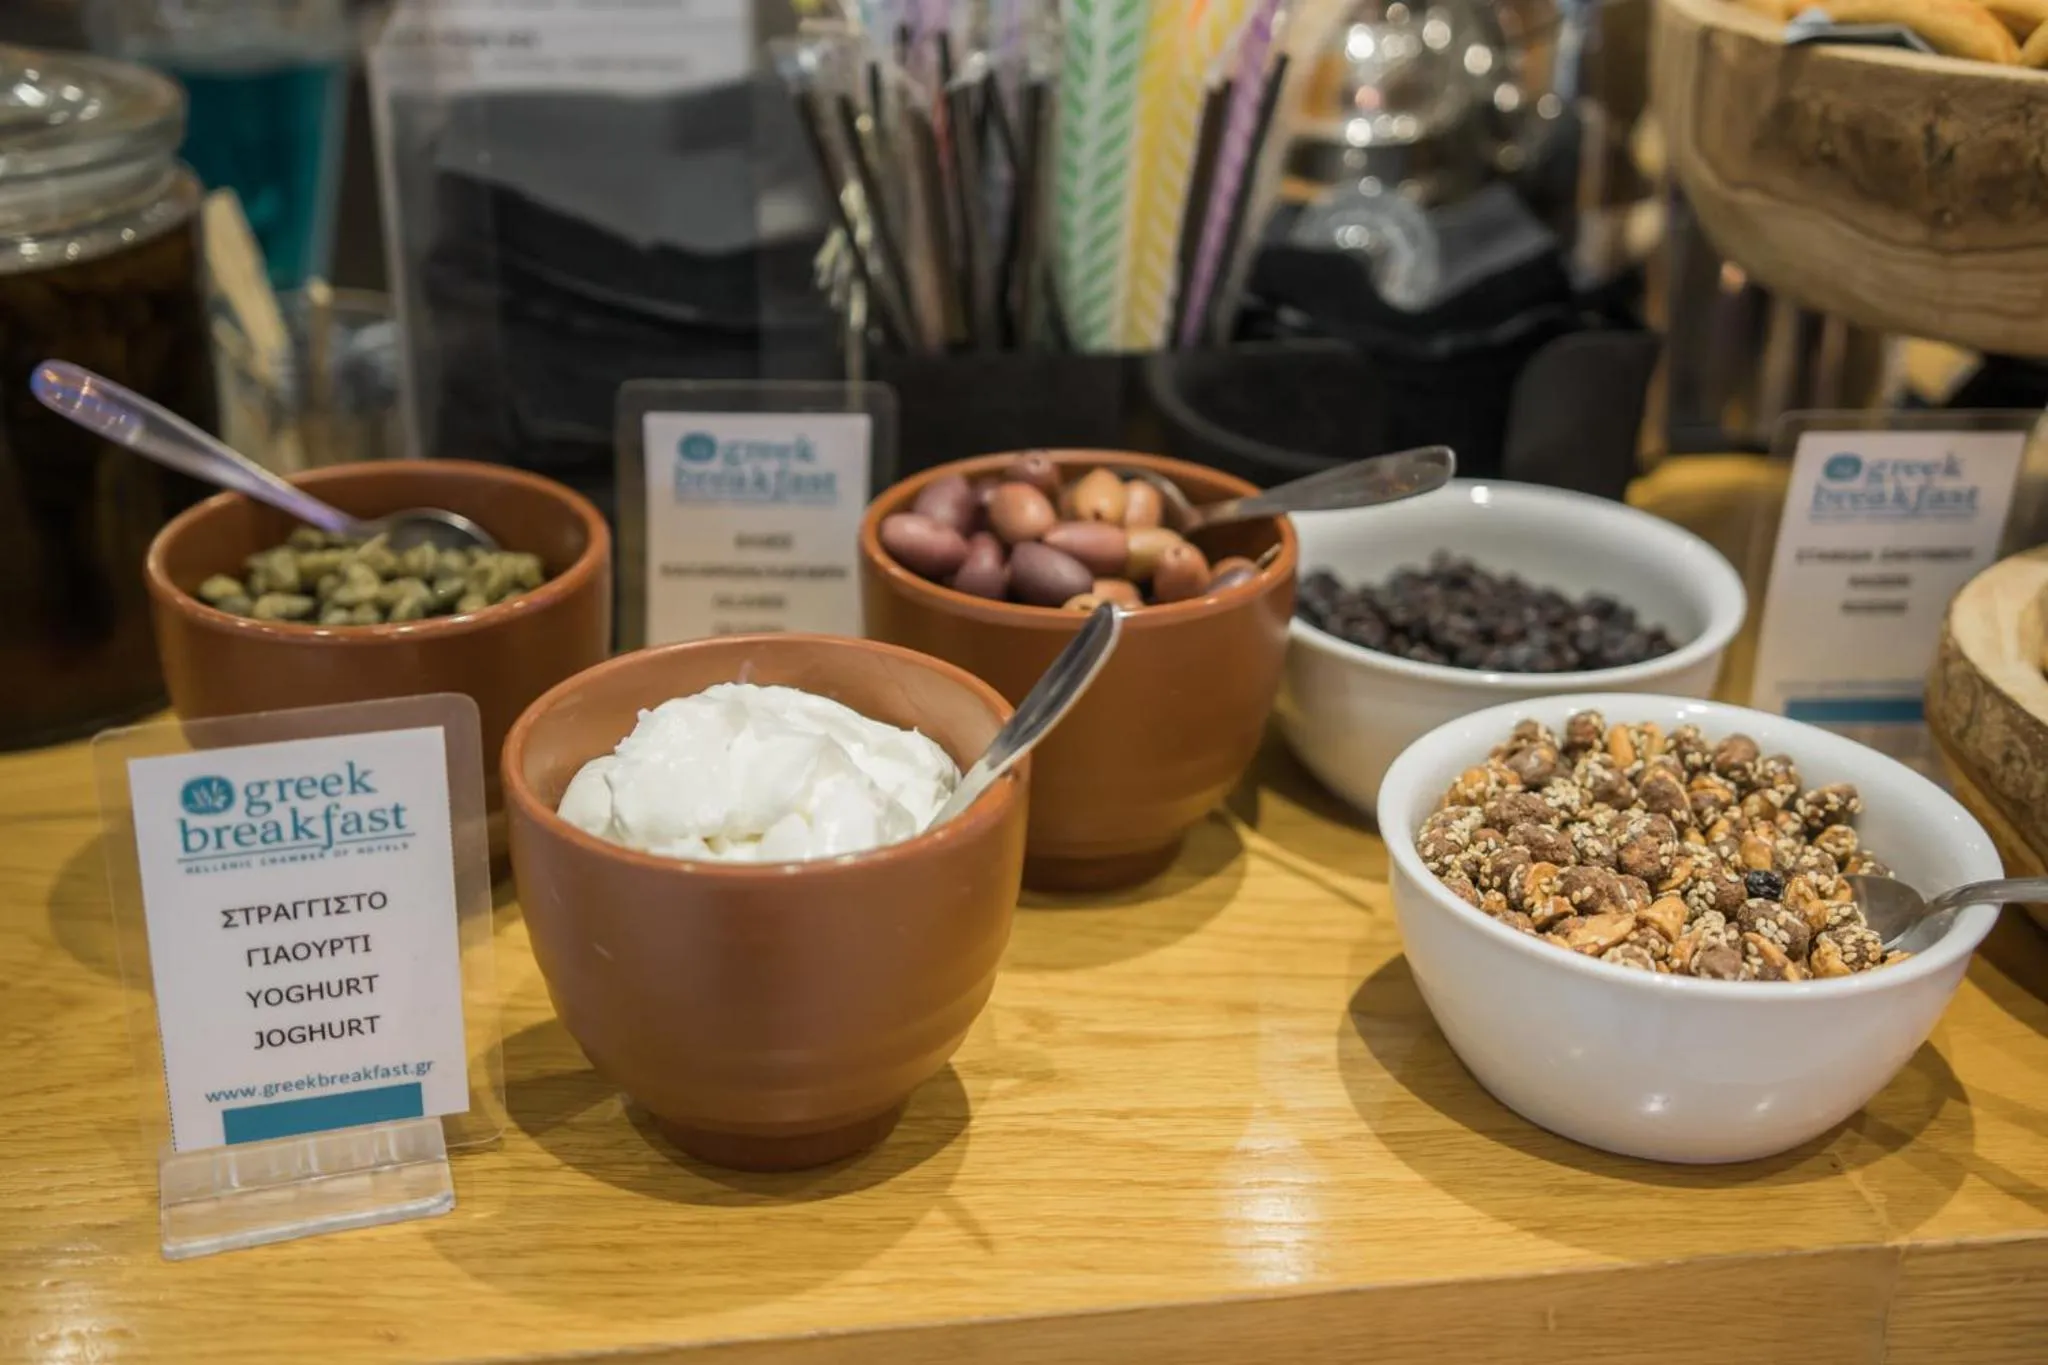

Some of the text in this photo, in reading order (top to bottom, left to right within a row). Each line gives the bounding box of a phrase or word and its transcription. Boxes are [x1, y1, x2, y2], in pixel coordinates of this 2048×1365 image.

[1867, 452, 1963, 484] greek
[1811, 482, 1980, 514] breakfast
[243, 760, 378, 818] greek
[177, 802, 408, 855] breakfast
[184, 859, 253, 876] HELLENIC
[260, 851, 326, 868] CHAMBER
[333, 848, 350, 860] OF
[220, 891, 389, 930] ΣΤΡΑΓΓΙΣΤΟ
[246, 933, 373, 968] ΓΙΑΟΥΡΤΙ
[245, 973, 380, 1009] YOGHURT
[253, 1014, 382, 1051] JOGHURT
[204, 1060, 434, 1104] www.greekbreakfast.gr
